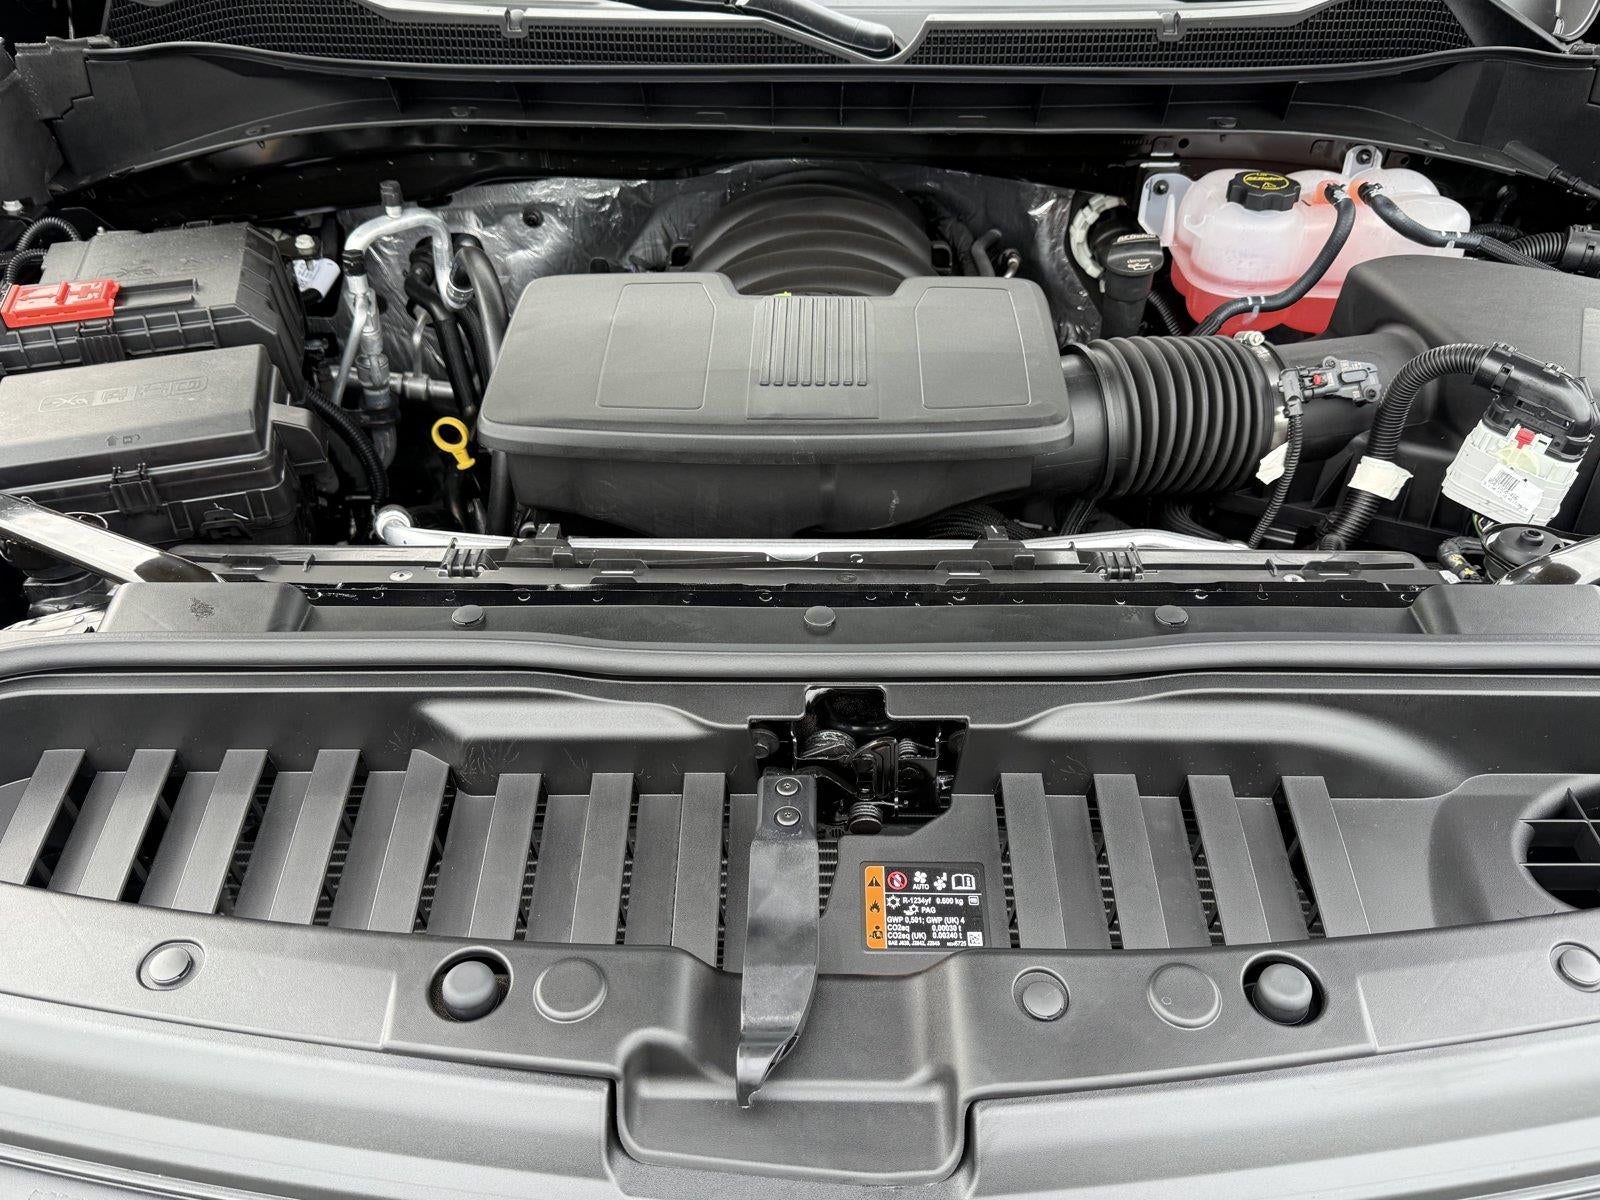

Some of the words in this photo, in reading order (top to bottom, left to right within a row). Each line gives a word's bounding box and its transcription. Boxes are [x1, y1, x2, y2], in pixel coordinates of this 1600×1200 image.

[902, 896, 932, 906] R-1234yf
[935, 896, 954, 905] 0.600
[954, 897, 964, 906] kg
[921, 906, 937, 914] PAG
[925, 916, 943, 924] GWP
[944, 916, 960, 926] (UK)
[960, 916, 966, 924] 4
[886, 924, 910, 932] CO2eq
[958, 924, 962, 932] t
[887, 931, 911, 940] CO2eq
[911, 931, 927, 941] (UK)
[959, 931, 963, 940] t
